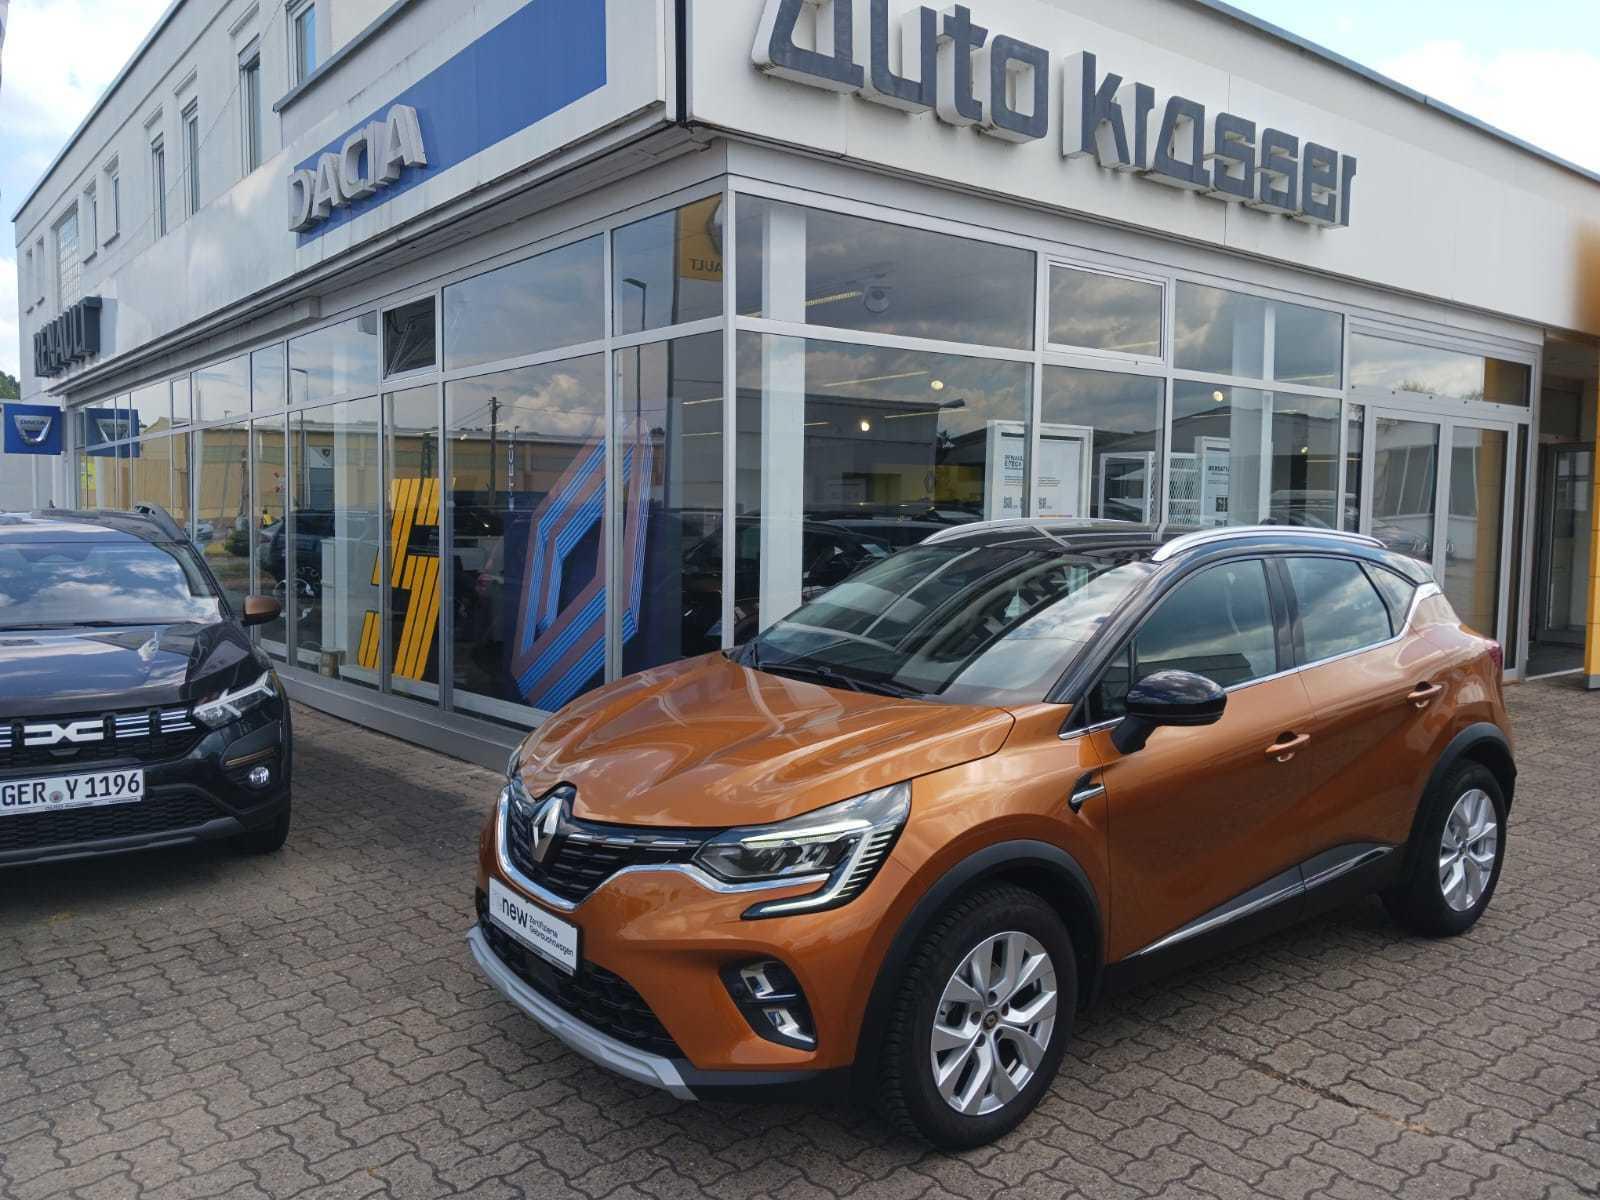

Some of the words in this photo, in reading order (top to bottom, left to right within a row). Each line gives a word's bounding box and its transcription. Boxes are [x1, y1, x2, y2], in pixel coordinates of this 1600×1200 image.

[288, 104, 428, 232] DACIA
[33, 296, 103, 378] RENAULT
[1, 781, 46, 807] GER
[65, 778, 79, 800] Y
[85, 771, 140, 799] 1196
[502, 897, 528, 929] new
